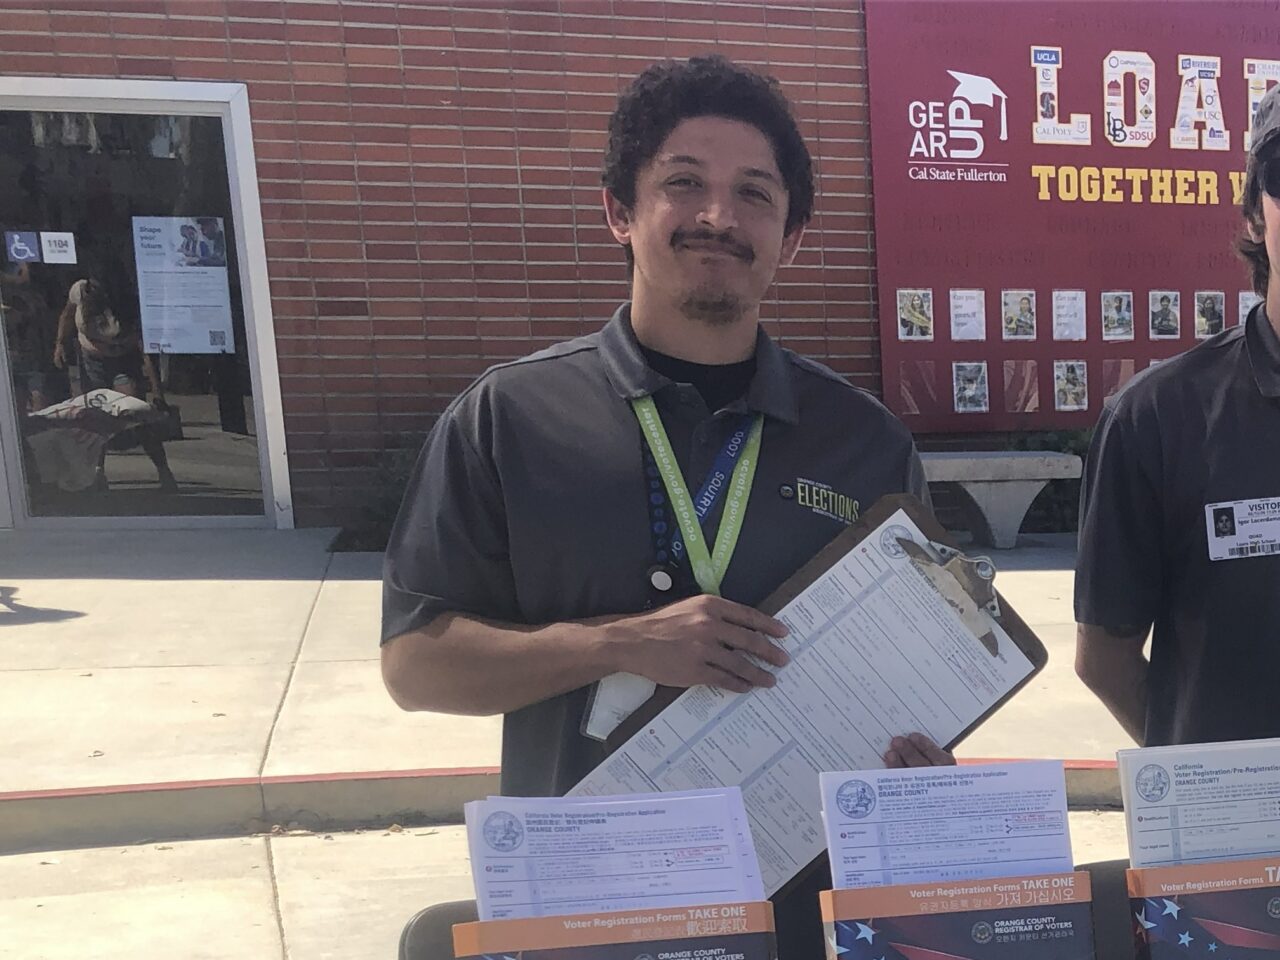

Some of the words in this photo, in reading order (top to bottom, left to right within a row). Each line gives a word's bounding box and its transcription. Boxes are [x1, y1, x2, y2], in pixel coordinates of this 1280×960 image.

[1036, 52, 1057, 62] UCLA
[908, 100, 946, 130] GE
[1128, 129, 1154, 142] SDSU
[908, 166, 929, 181] Cal
[929, 167, 957, 182] State
[957, 167, 1008, 182] Fullerton
[1031, 164, 1221, 206] TOGETHER
[797, 482, 860, 523] ELECTIONS
[910, 889, 936, 899] Voter
[936, 885, 993, 898] Registration
[1021, 878, 1050, 891] TAKE
[1051, 876, 1075, 888] ONE
[1161, 882, 1186, 893] Voter
[1185, 878, 1238, 892] Registration
[1024, 887, 1076, 905] 가십시오
[563, 919, 593, 930] Voter
[593, 915, 656, 929] Registration
[687, 908, 719, 921] TAKE
[720, 906, 747, 918] ONE
